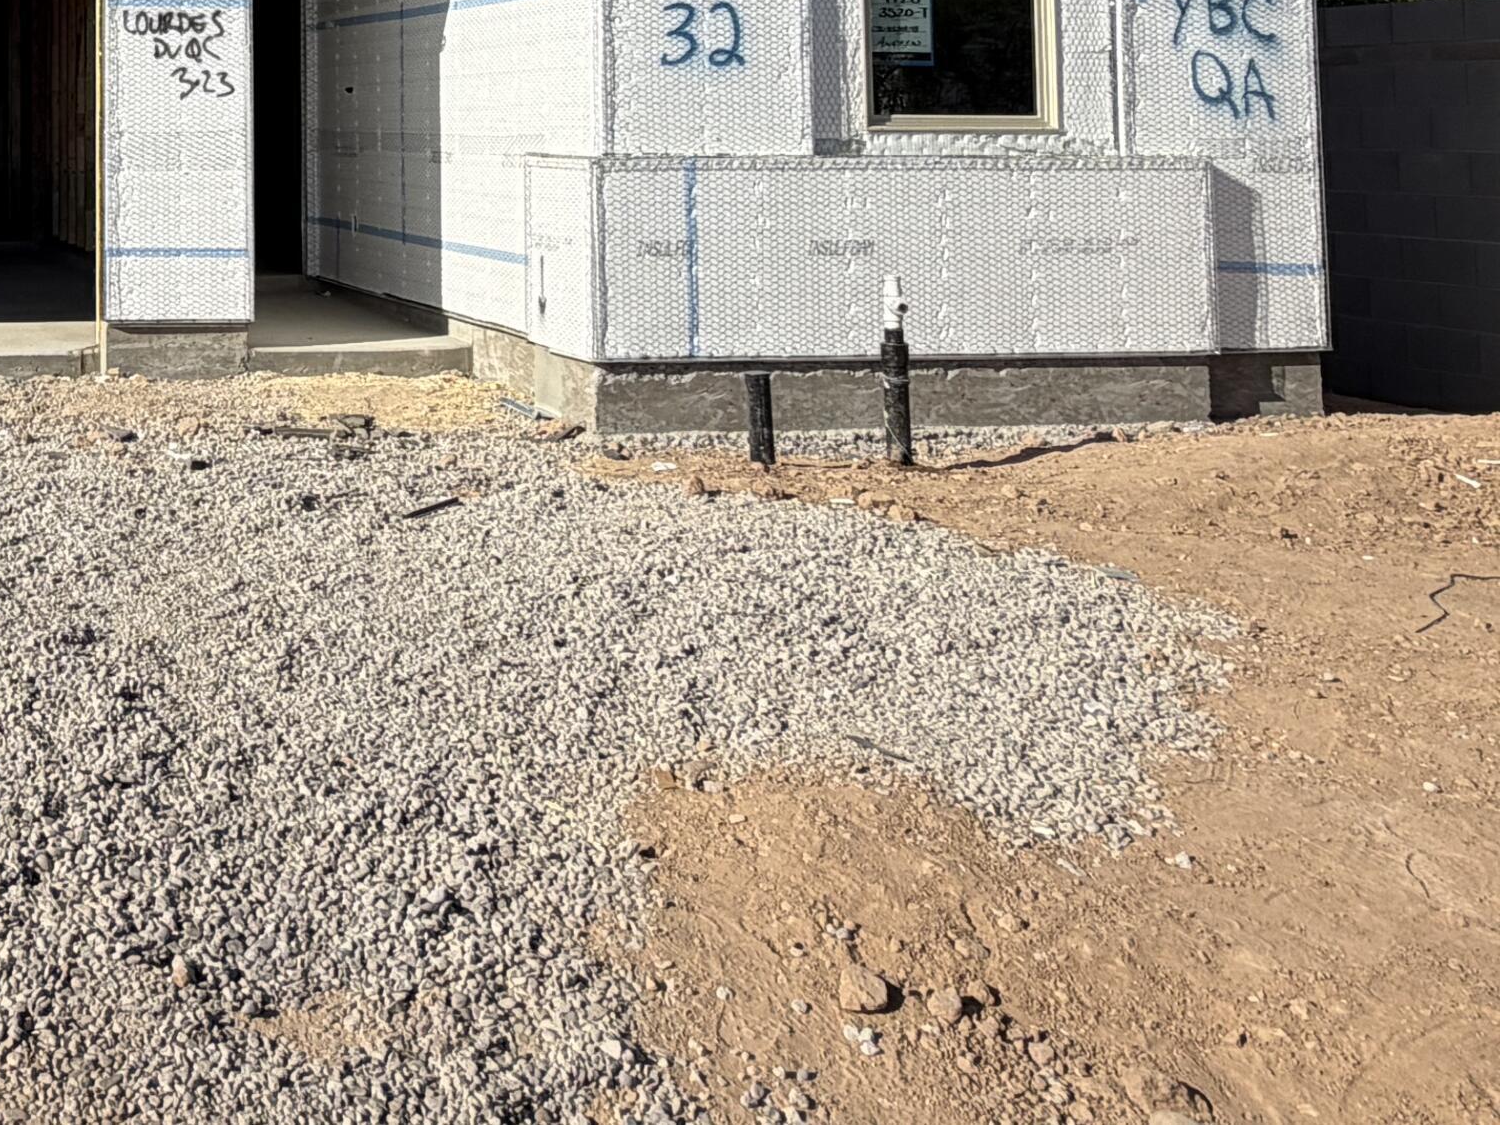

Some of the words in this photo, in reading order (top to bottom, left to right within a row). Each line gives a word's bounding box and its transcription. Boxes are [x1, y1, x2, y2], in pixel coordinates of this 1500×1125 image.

[122, 10, 224, 37] LOURDES
[661, 1, 745, 67] 32
[1191, 50, 1275, 120] QA
